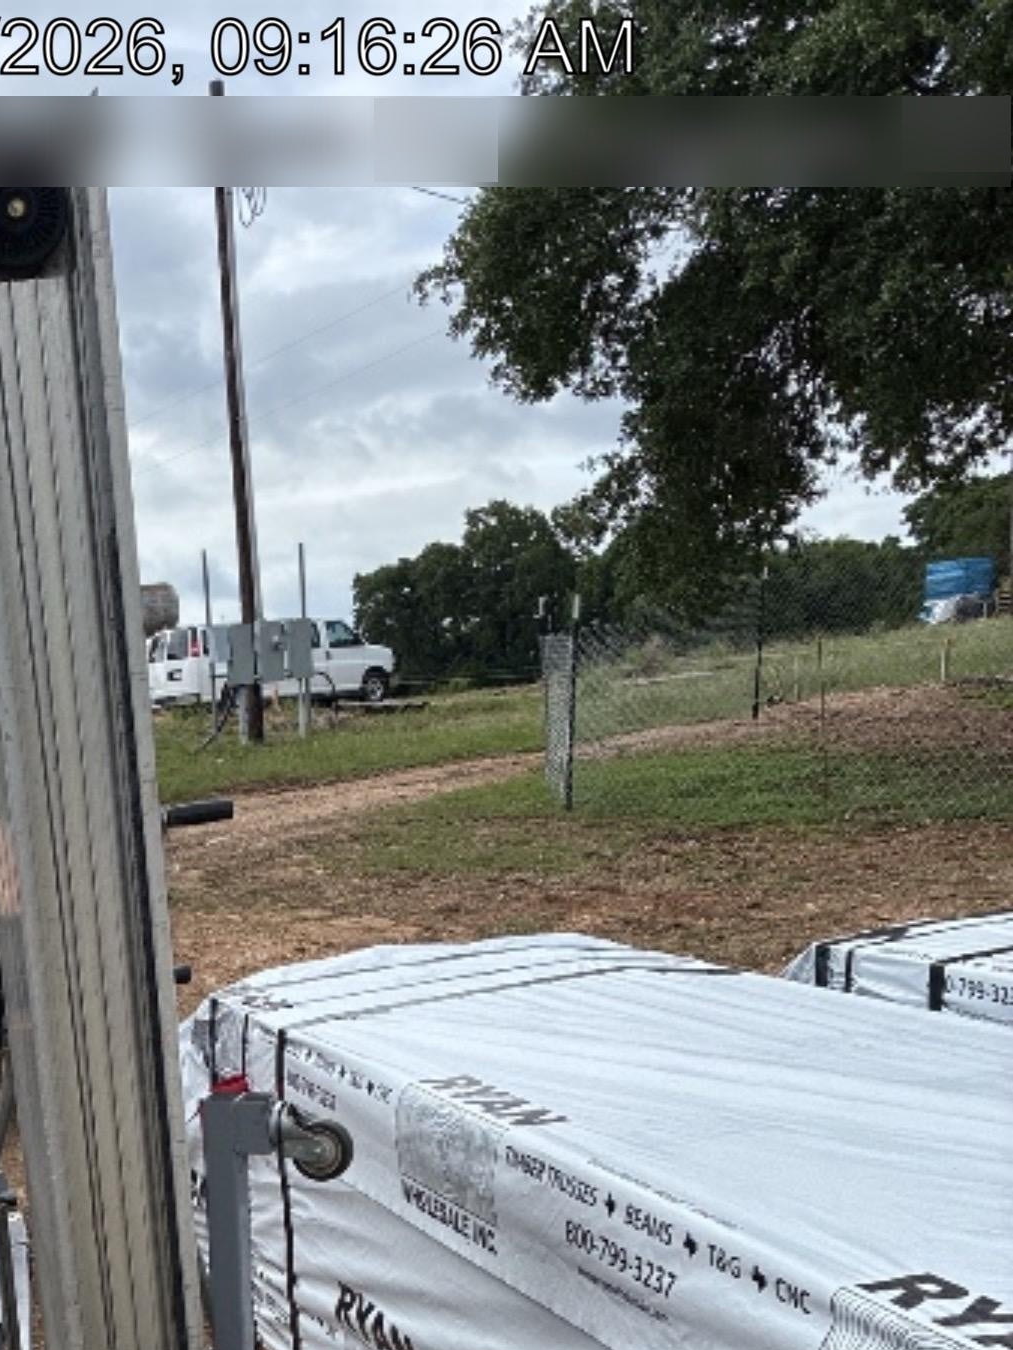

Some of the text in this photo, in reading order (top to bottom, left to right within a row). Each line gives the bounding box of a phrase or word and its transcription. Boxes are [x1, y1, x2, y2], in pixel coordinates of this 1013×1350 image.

[419, 1074, 568, 1126] RYAN
[565, 1220, 678, 1299] 800-799-3237
[624, 1204, 673, 1246] BEAMS
[707, 1244, 741, 1279] T&G
[776, 1277, 811, 1314] CNC
[854, 1272, 1013, 1350] RY
